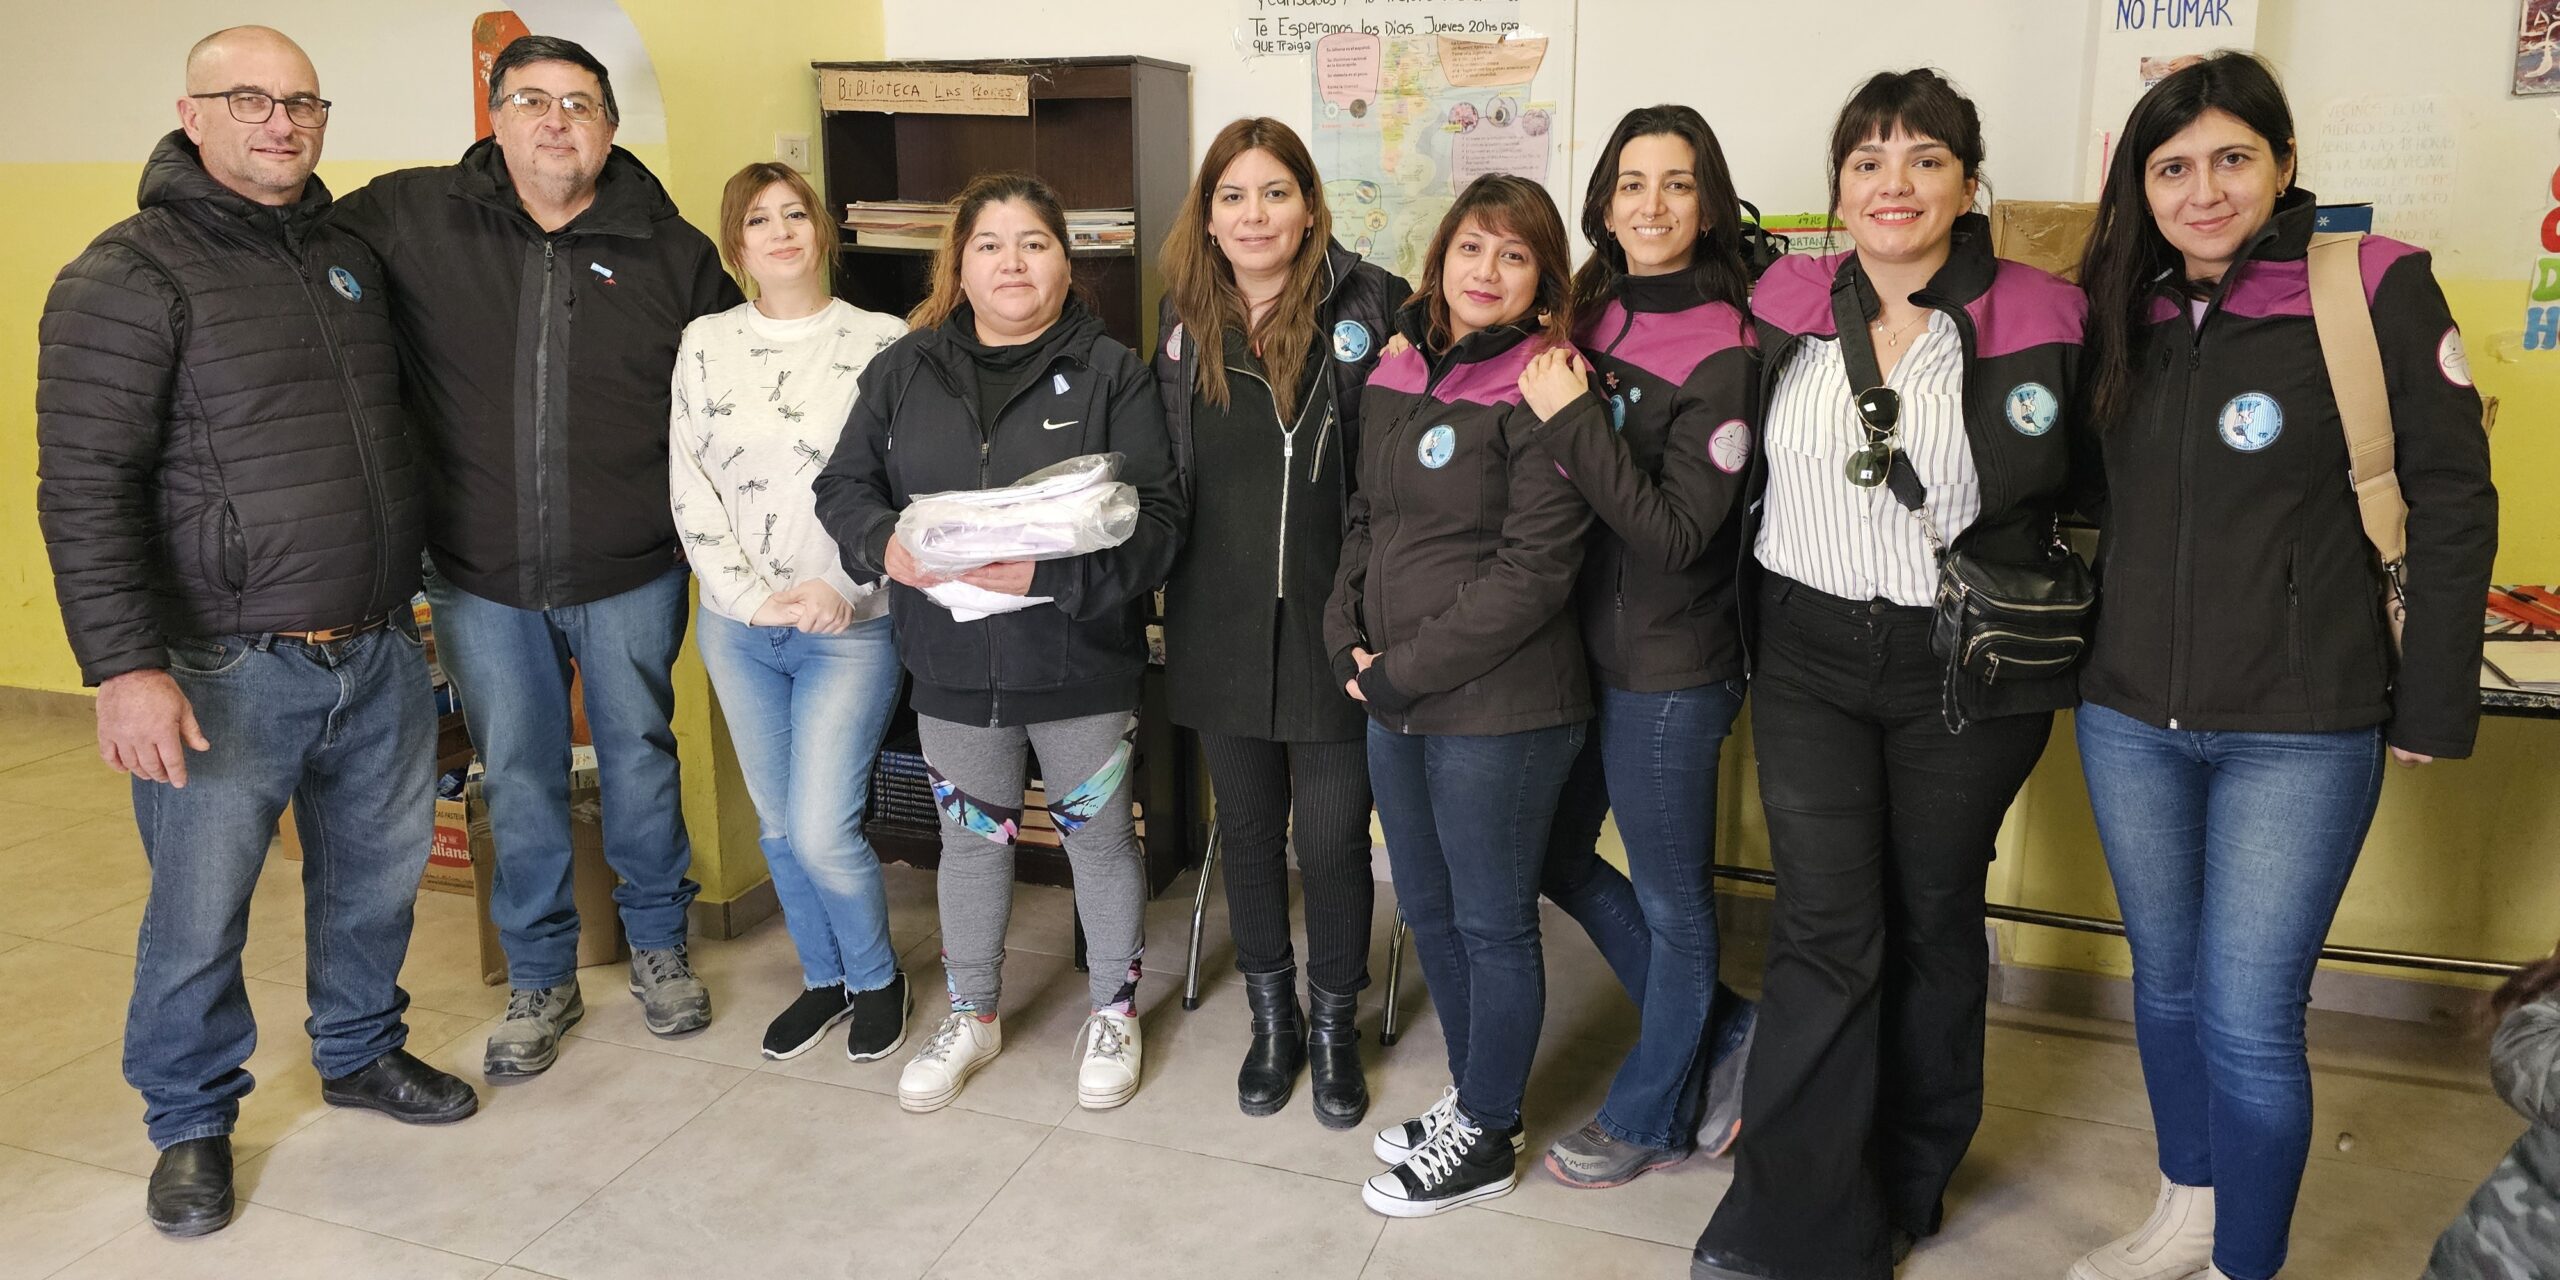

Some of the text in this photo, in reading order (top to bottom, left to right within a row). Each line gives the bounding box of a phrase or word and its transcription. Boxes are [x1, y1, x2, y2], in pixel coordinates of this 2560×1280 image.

[2116, 0, 2233, 30] NO FUMAR
[1248, 17, 1268, 37] Te
[1278, 16, 1353, 40] Esperamos
[1361, 18, 1380, 36] los
[1424, 15, 1465, 35] Jueves
[1468, 19, 1498, 33] 20hs
[1790, 236, 1836, 247] ORTANE
[431, 841, 470, 861] aliana
